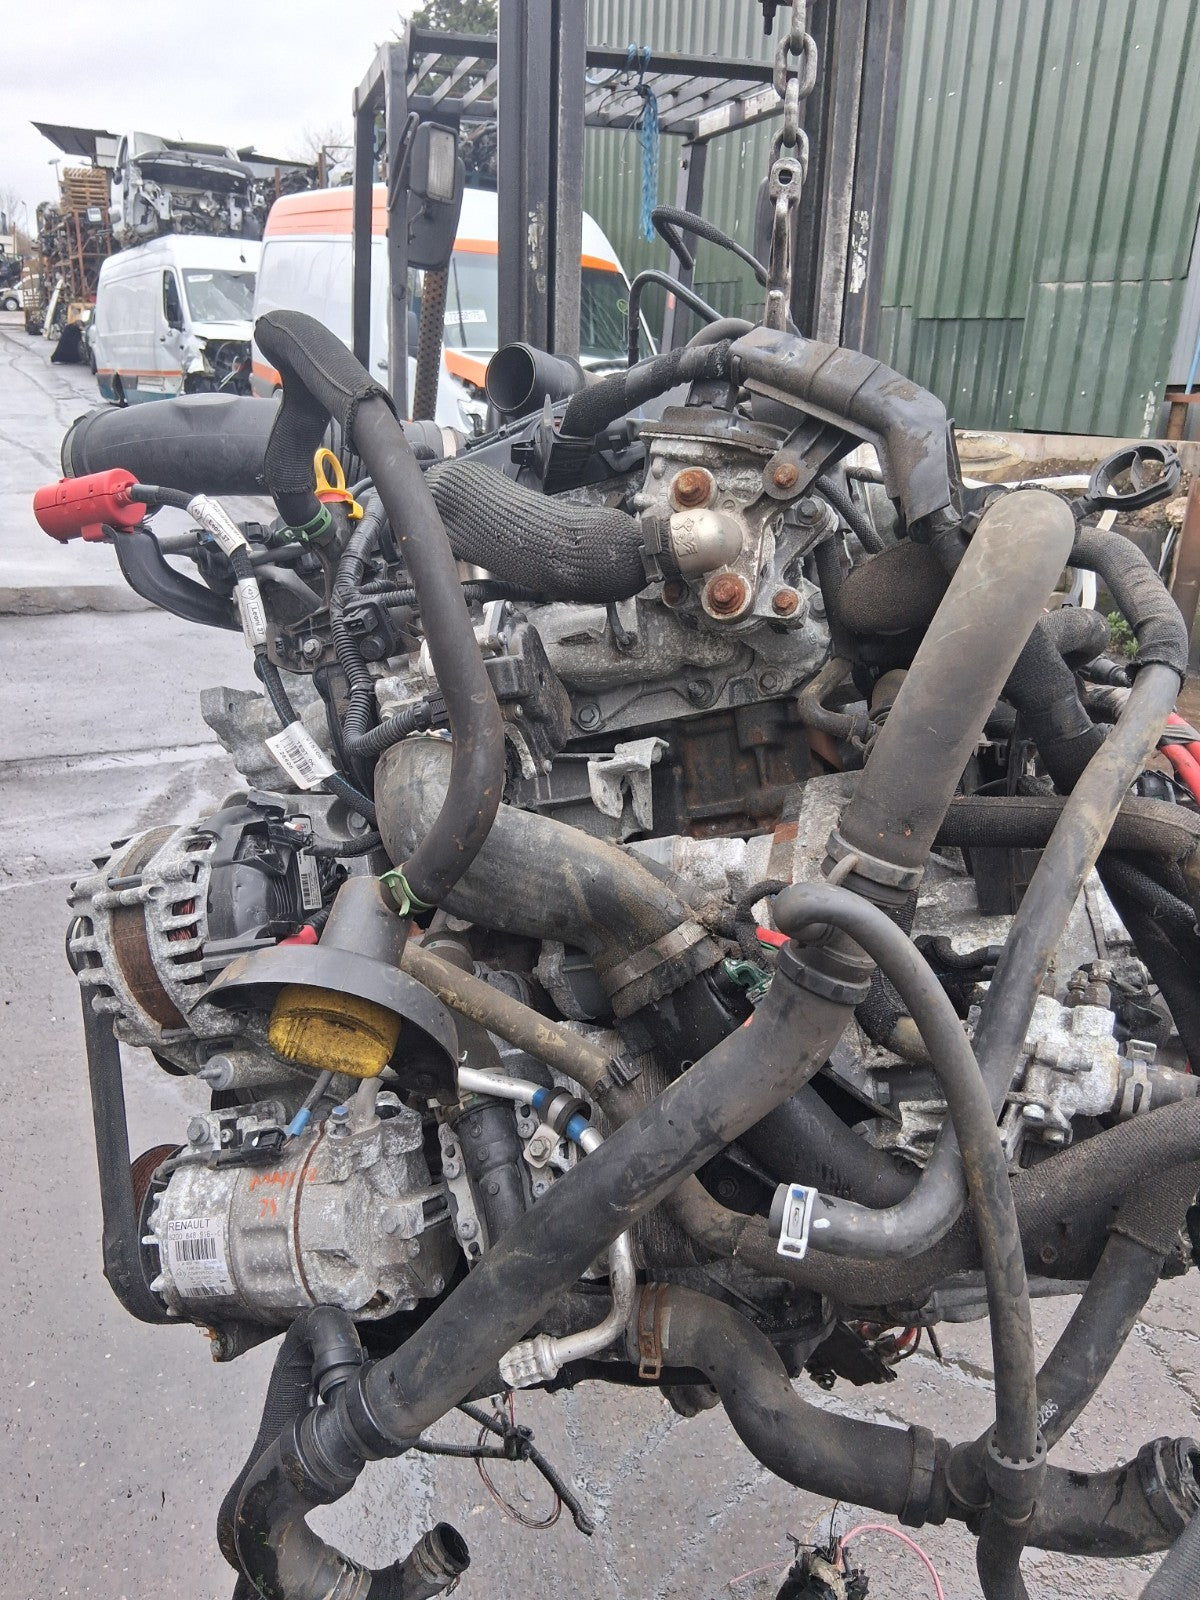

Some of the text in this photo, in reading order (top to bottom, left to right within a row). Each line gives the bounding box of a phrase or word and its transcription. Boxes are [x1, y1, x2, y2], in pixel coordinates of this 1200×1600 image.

[251, 606, 262, 627] Leoni
[296, 740, 309, 756] TEST
[305, 736, 324, 760] VISION
[168, 1218, 211, 1231] RENAULT
